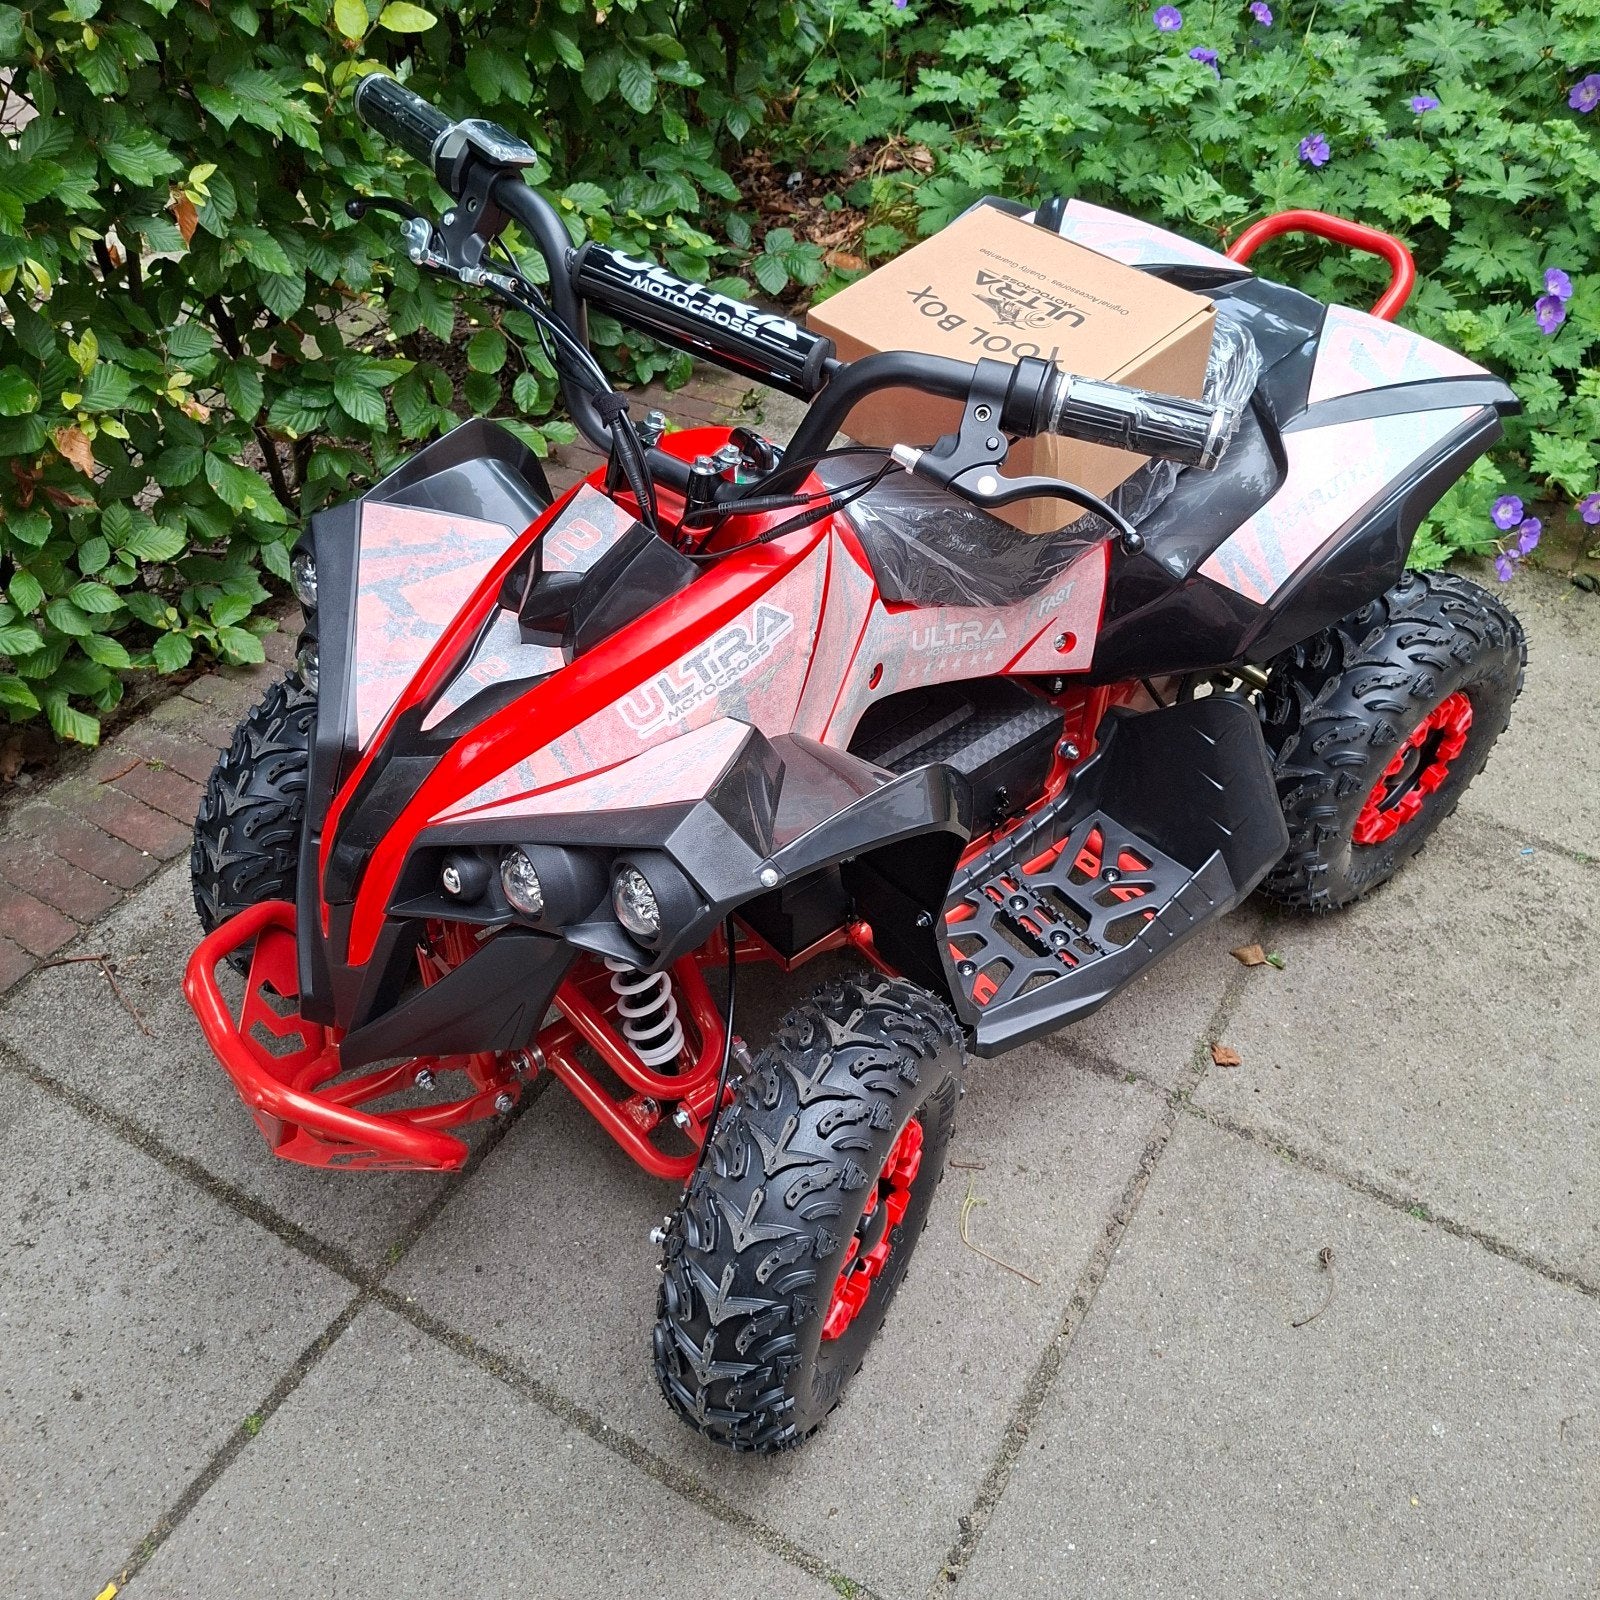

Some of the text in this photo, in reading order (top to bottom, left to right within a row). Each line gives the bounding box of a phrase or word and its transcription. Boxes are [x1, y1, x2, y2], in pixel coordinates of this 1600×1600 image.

[1001, 275, 1076, 310] MOTOCROSS
[1019, 265, 1047, 281] Quality
[1051, 279, 1100, 303] Accessories
[630, 275, 758, 338] MOTOCROSS
[976, 270, 1085, 328] ULTRA
[907, 285, 1064, 364] TOOL BOX
[1038, 581, 1075, 618] FAST
[912, 618, 1007, 651] ULTRA
[616, 602, 793, 733] ULTRA
[667, 643, 770, 720] MOTOCROSS
